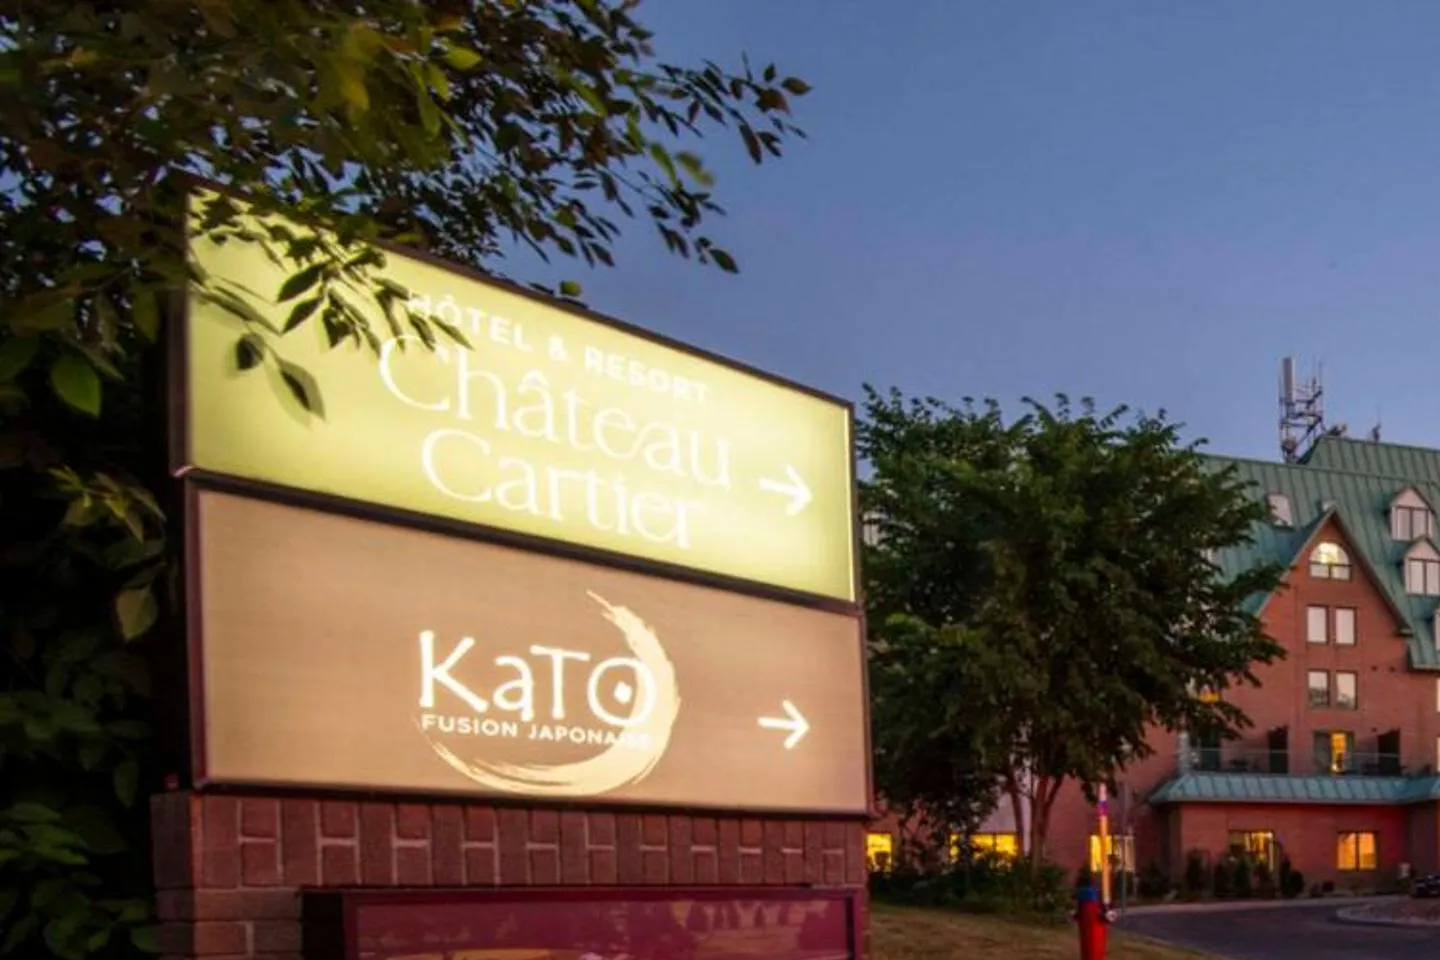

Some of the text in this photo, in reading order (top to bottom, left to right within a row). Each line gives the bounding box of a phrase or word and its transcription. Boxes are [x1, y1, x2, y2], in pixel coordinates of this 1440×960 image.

[409, 294, 708, 404] HÔTEL & RESORT
[377, 334, 733, 492] Château
[420, 428, 708, 549] Cartier
[421, 713, 650, 748] FUSION JAPONA
